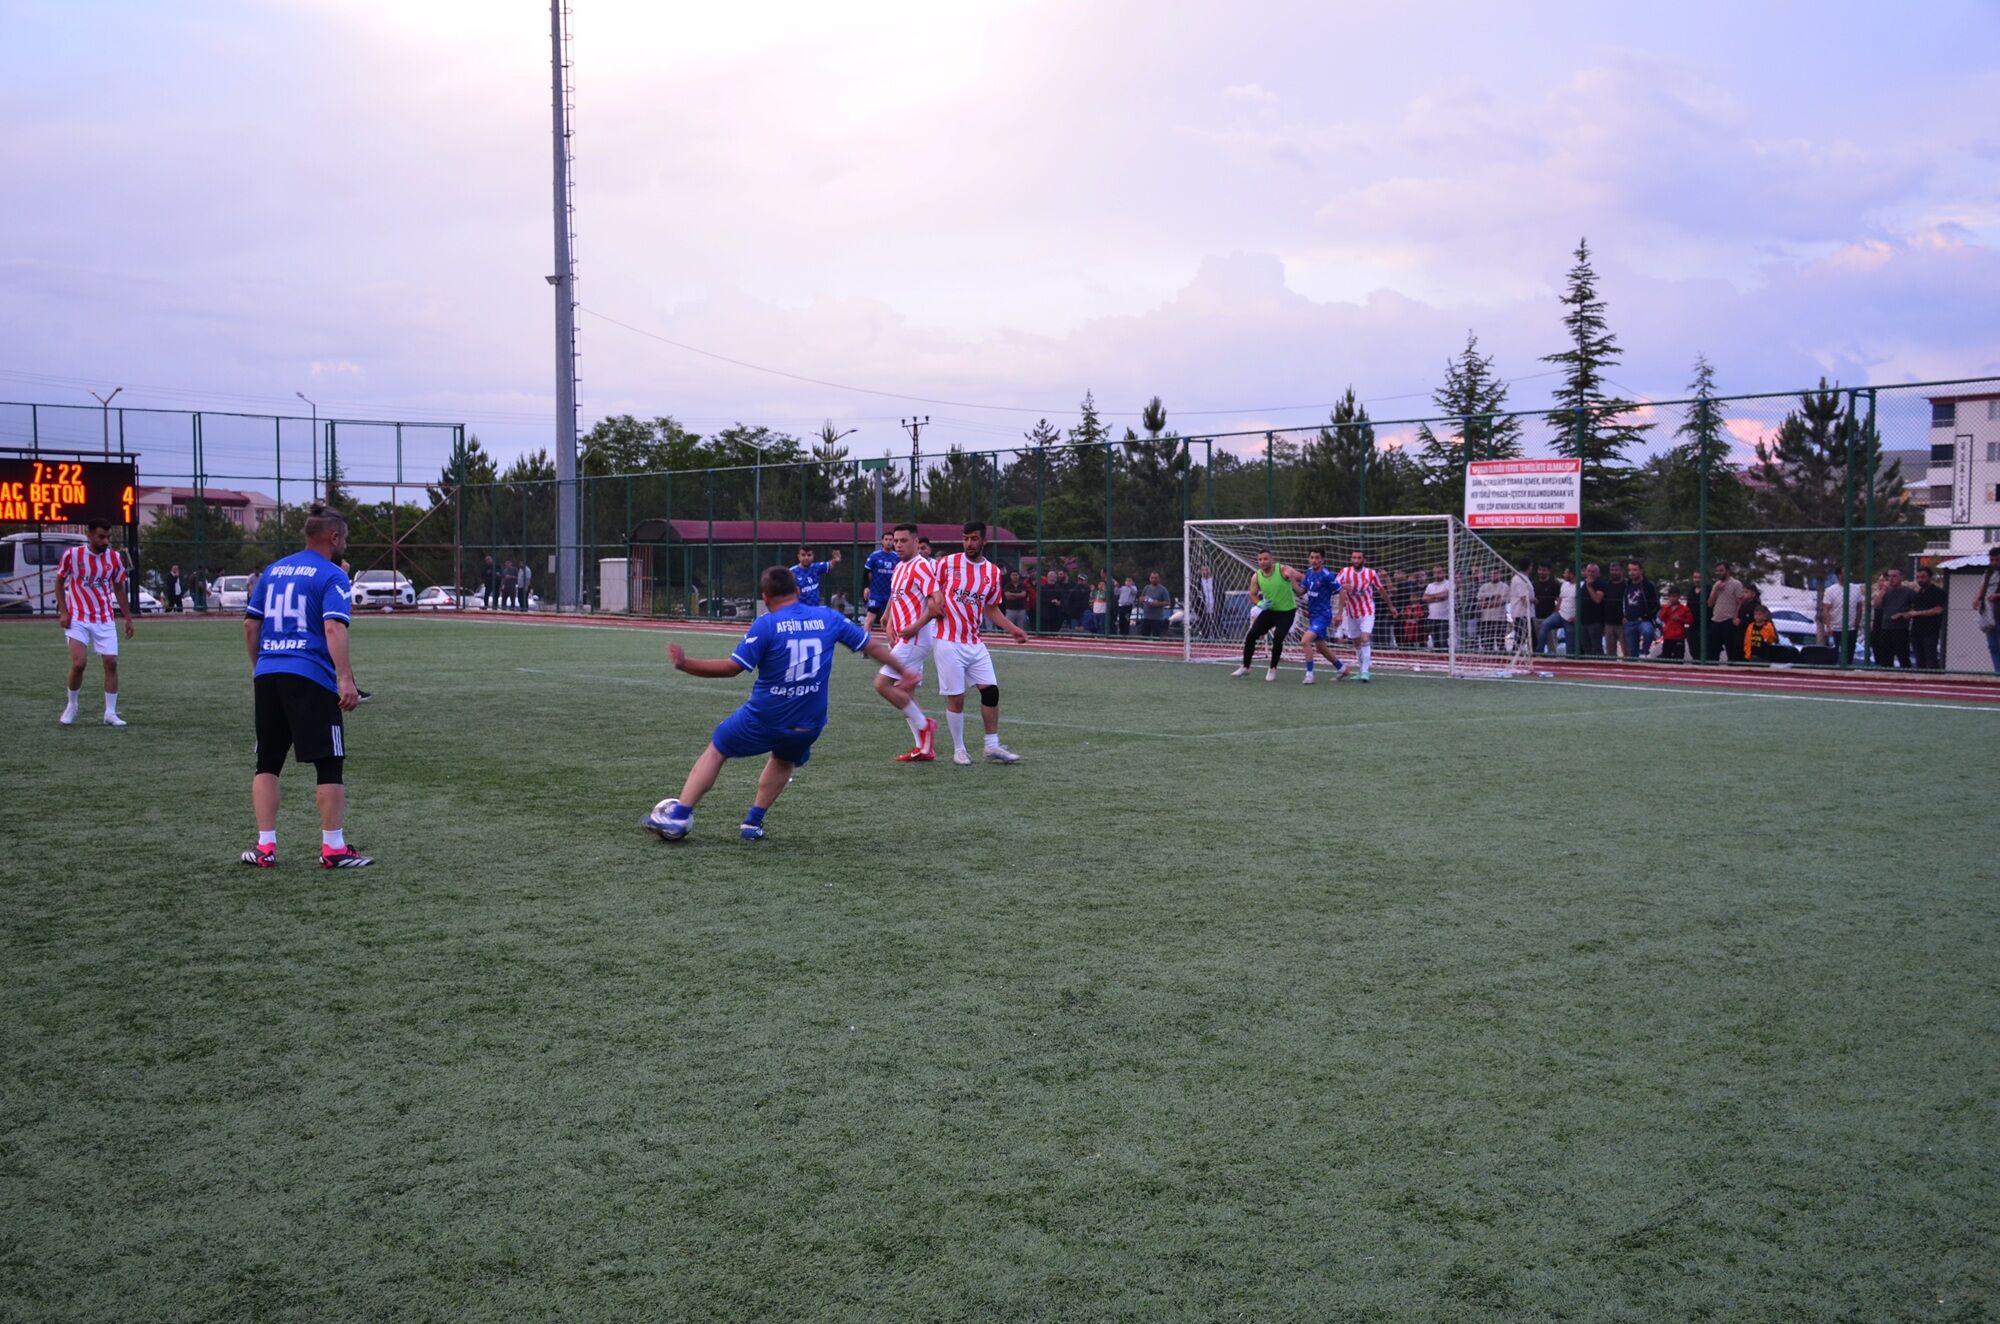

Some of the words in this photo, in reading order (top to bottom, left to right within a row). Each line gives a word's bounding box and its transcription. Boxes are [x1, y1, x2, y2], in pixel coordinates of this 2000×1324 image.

[30, 483, 85, 504] BETON
[122, 486, 134, 506] 4
[34, 503, 68, 521] F.C.
[122, 504, 131, 523] 1
[270, 564, 294, 578] AFŞİN
[294, 565, 318, 577] AKDO
[264, 582, 308, 632] 44
[777, 618, 802, 634] AFŞİN
[803, 619, 825, 631] AKDO
[263, 639, 307, 650] EMRE
[784, 638, 823, 682] 10
